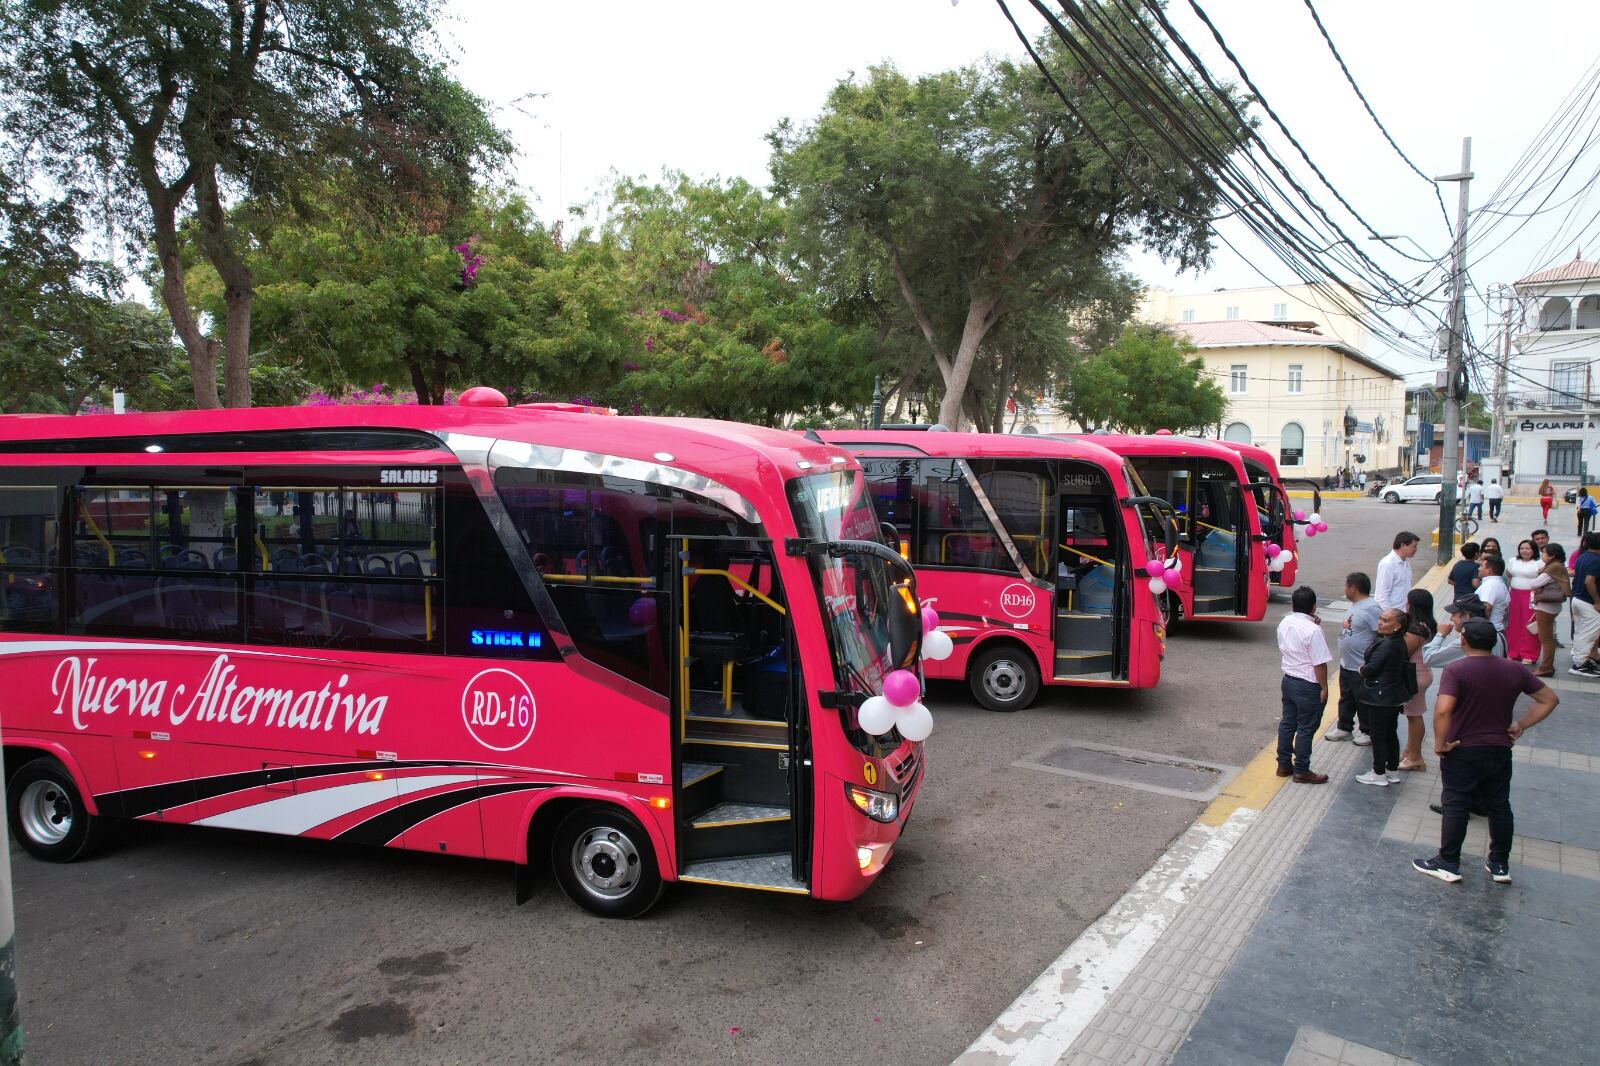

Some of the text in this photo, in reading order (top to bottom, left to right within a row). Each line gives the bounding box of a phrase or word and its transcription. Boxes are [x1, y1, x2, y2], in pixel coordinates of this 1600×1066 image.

[1536, 422, 1561, 430] CAJA
[379, 470, 438, 484] SALABUS
[1064, 473, 1102, 487] SUBIDA
[1003, 593, 1033, 606] RD-16
[470, 630, 524, 647] STICK
[51, 653, 389, 736] Nueva Alternativa
[471, 690, 529, 727] RD-16
